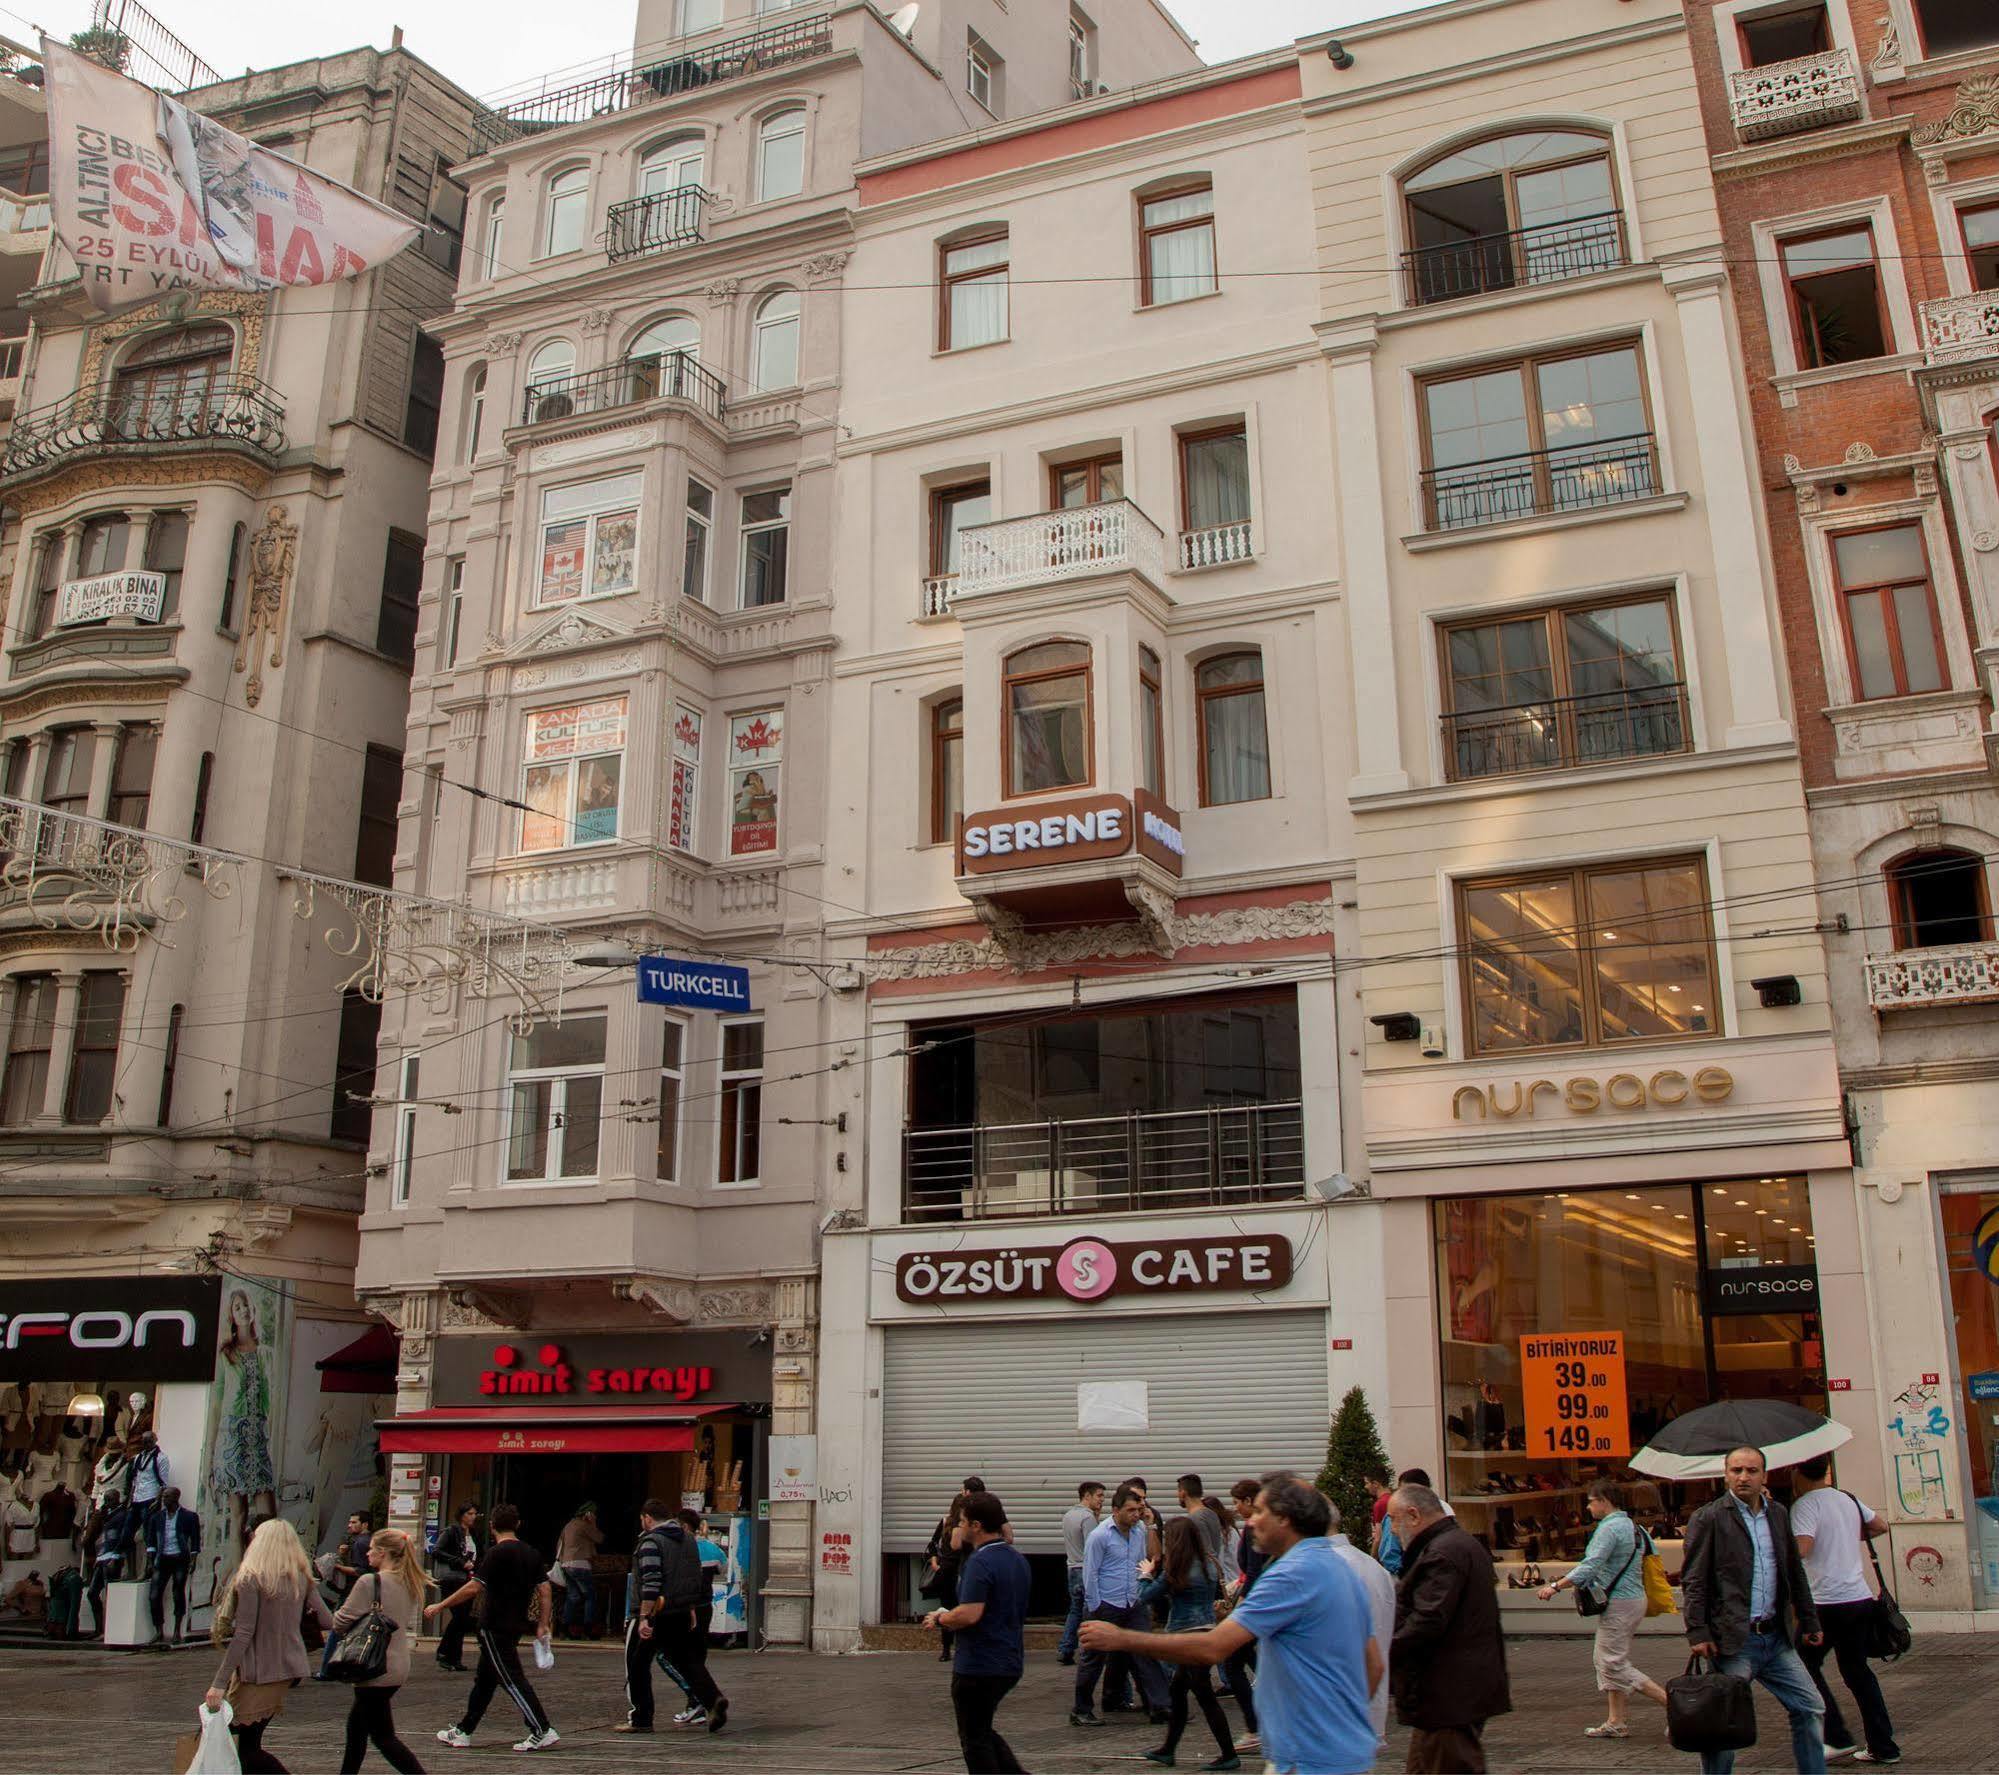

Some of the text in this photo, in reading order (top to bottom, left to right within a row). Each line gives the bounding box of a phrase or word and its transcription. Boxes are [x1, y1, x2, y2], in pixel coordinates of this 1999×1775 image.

[77, 235, 114, 258] 25
[82, 578, 124, 601] KIRALIK
[126, 575, 158, 596] BİNA
[141, 605, 155, 616] 70
[964, 808, 1122, 857] SERENE
[647, 970, 745, 999] TURKCELL
[1452, 1066, 1734, 1120] nursace
[904, 1251, 1052, 1296] ÖZSÜT
[1131, 1246, 1273, 1286] CAFE
[1720, 1278, 1814, 1296] nursace
[1526, 1338, 1618, 1358] BİTİRİYORUZ
[479, 1344, 714, 1401] simit sarayı
[1555, 1362, 1607, 1388] 39.00
[1833, 1381, 1847, 1389] 100
[1557, 1394, 1609, 1419] 99.00
[498, 1432, 566, 1450] simit sarayı
[1544, 1425, 1611, 1452] 149.00
